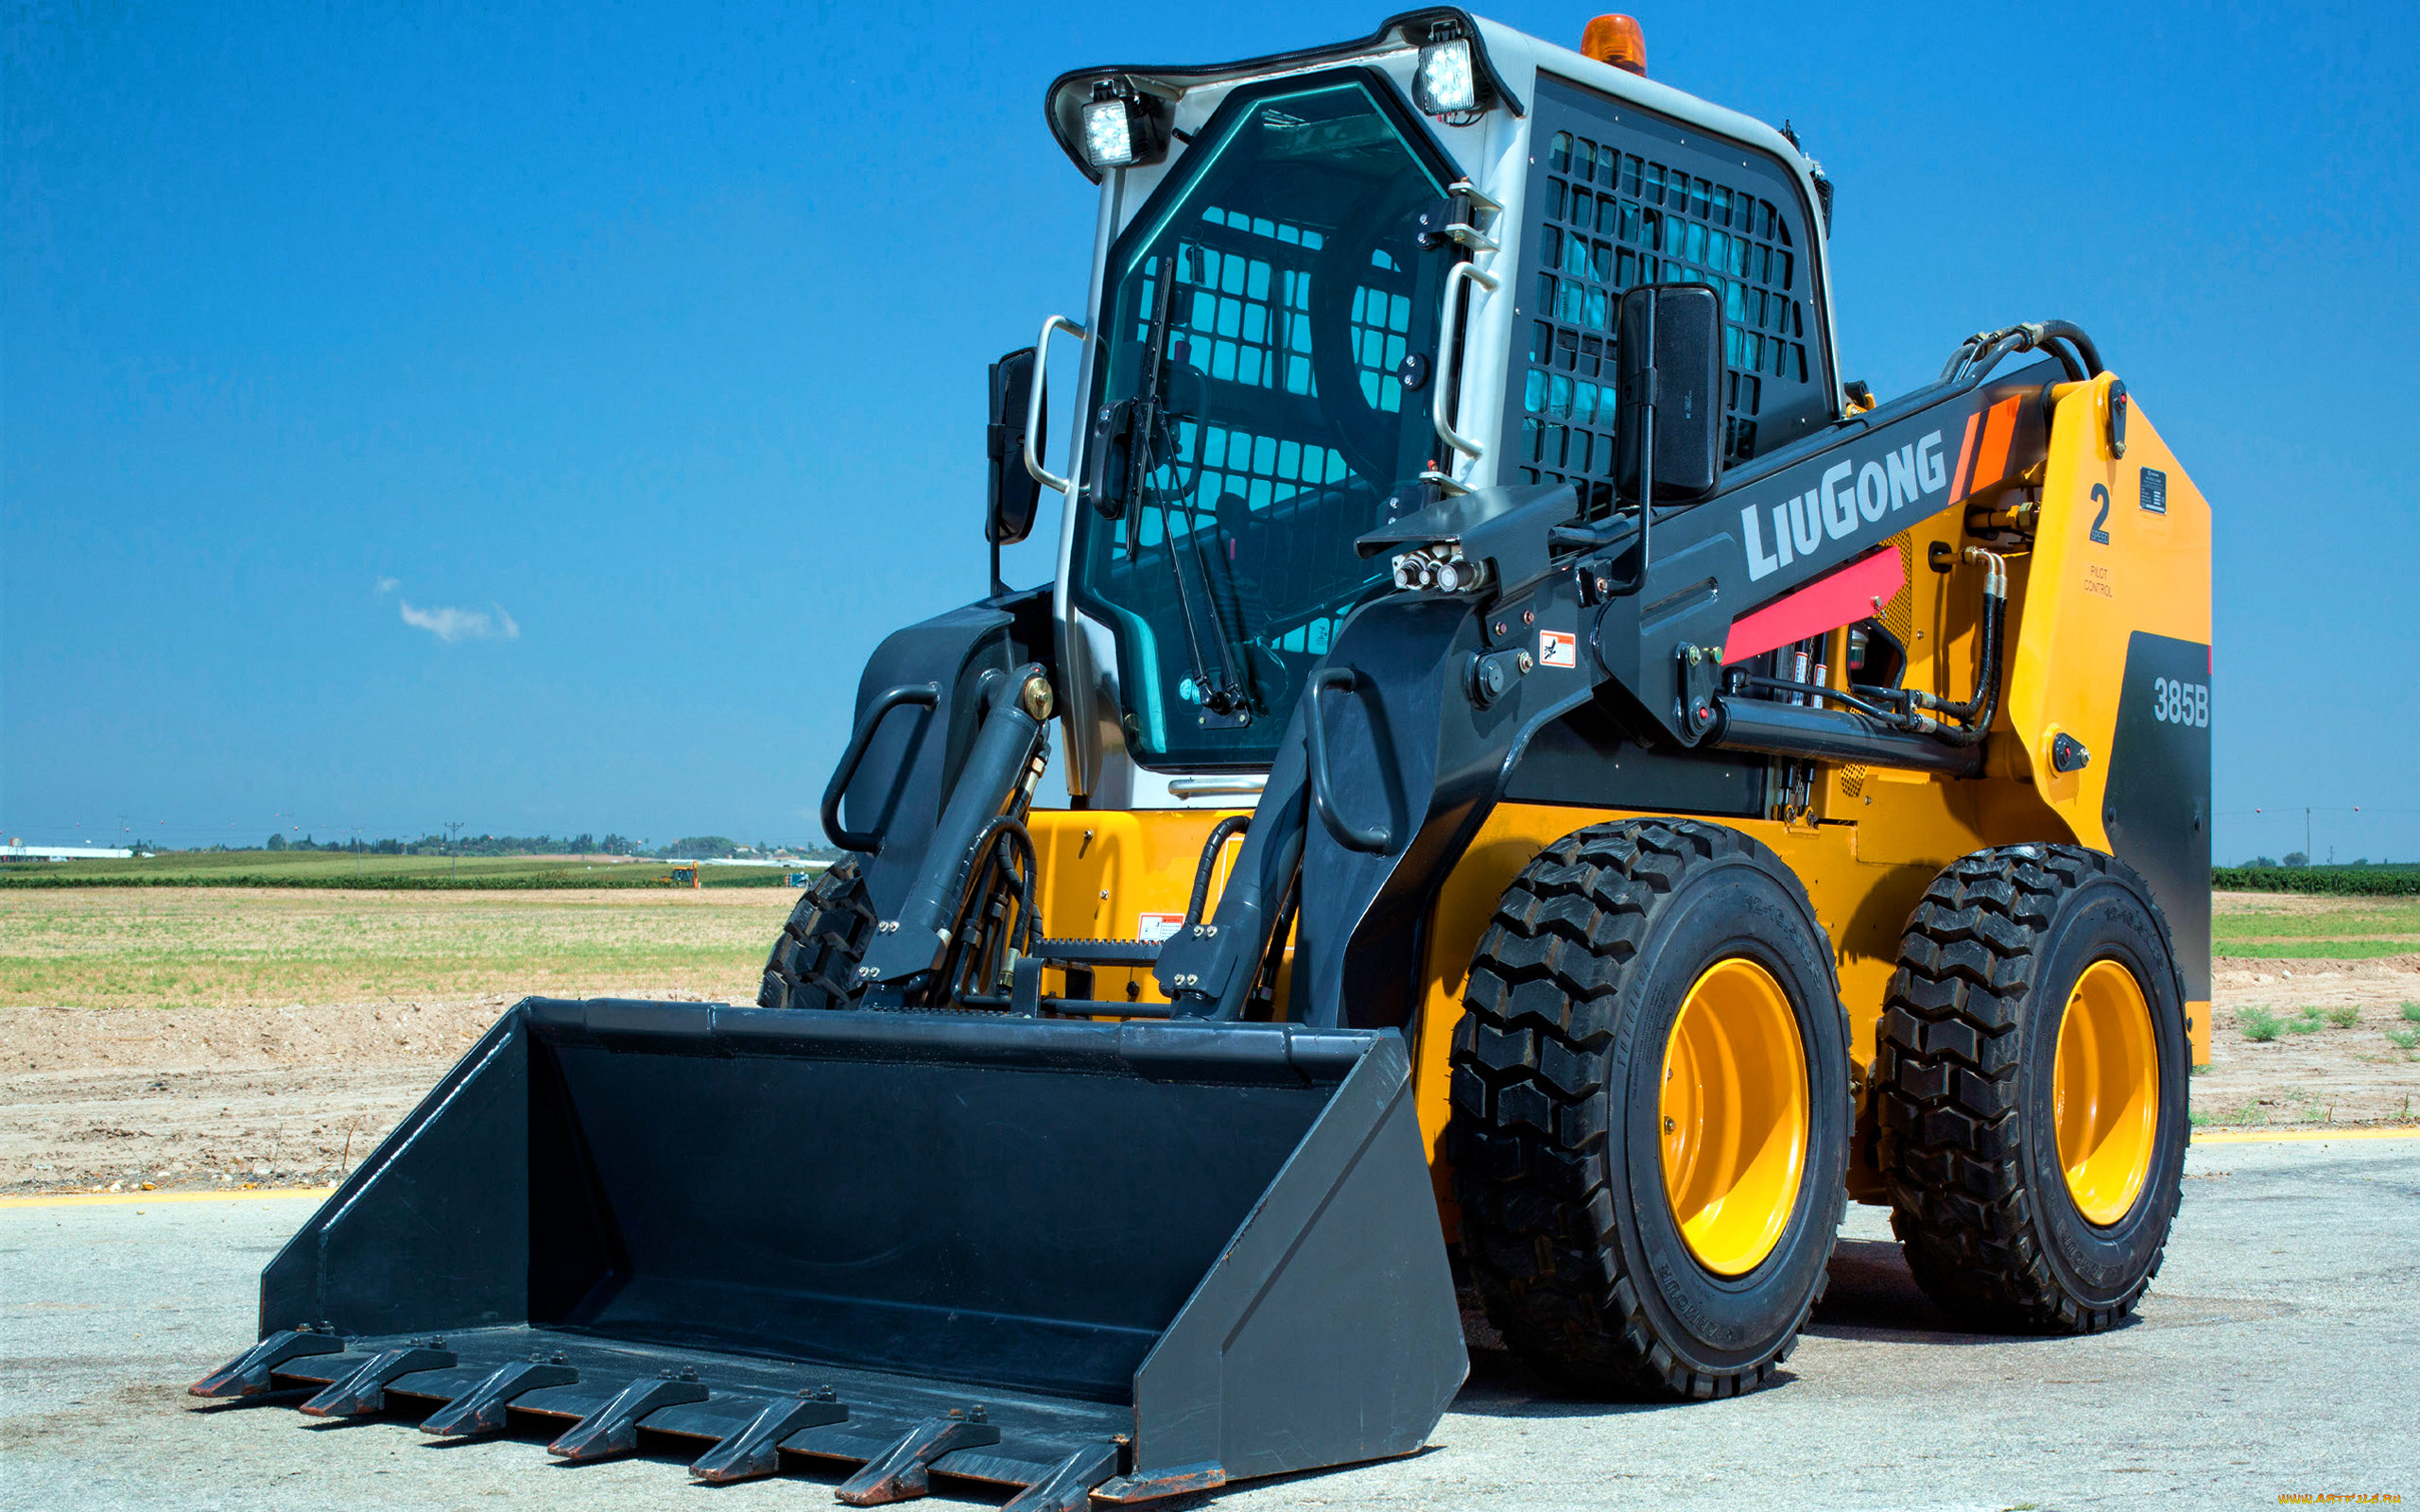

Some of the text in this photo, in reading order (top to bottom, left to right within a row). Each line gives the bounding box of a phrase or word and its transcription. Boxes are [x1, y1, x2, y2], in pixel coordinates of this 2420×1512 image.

[2090, 483, 2110, 545] 2
[2091, 529, 2109, 544] SPEED
[2090, 565, 2108, 580] PILOT
[2083, 579, 2113, 598] CONTROL
[2153, 677, 2209, 729] 385B
